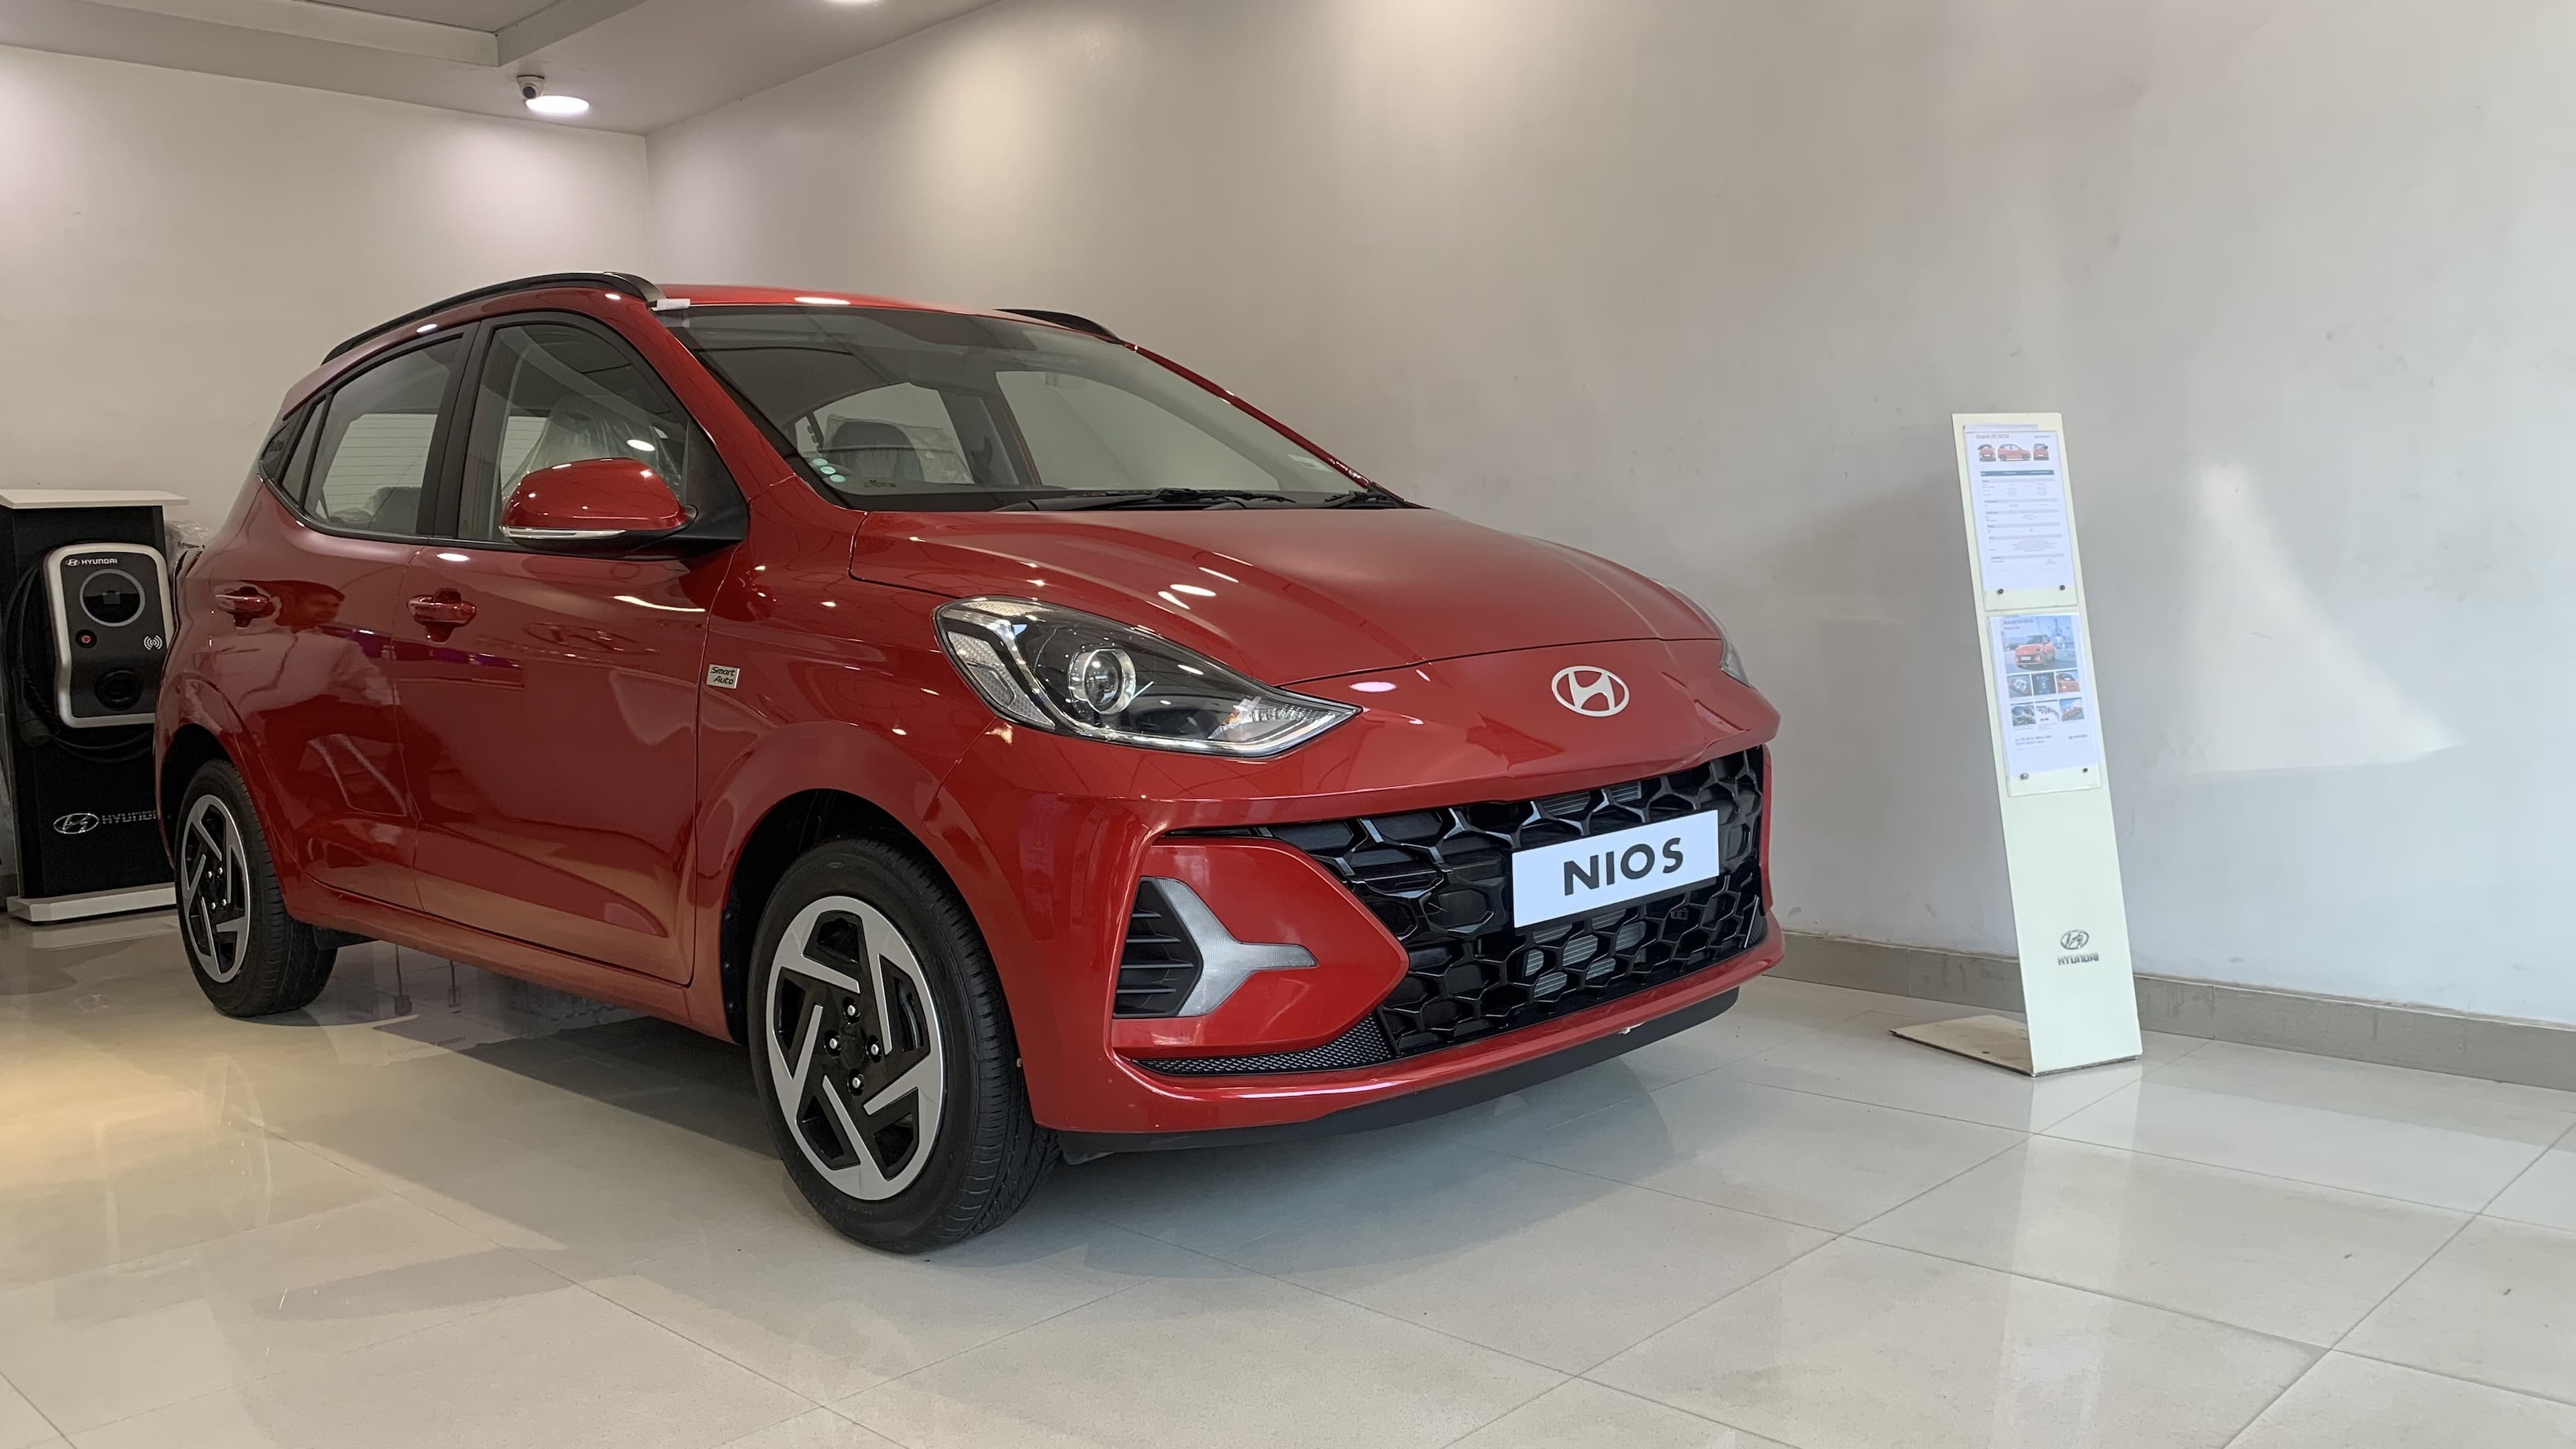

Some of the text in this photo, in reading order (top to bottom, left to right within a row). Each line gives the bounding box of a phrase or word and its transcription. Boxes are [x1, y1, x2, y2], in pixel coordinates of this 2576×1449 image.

[710, 666, 736, 676] Smart
[713, 676, 734, 685] Auto
[1564, 837, 1684, 896] NIOS
[2057, 953, 2099, 965] HYUNDAI
